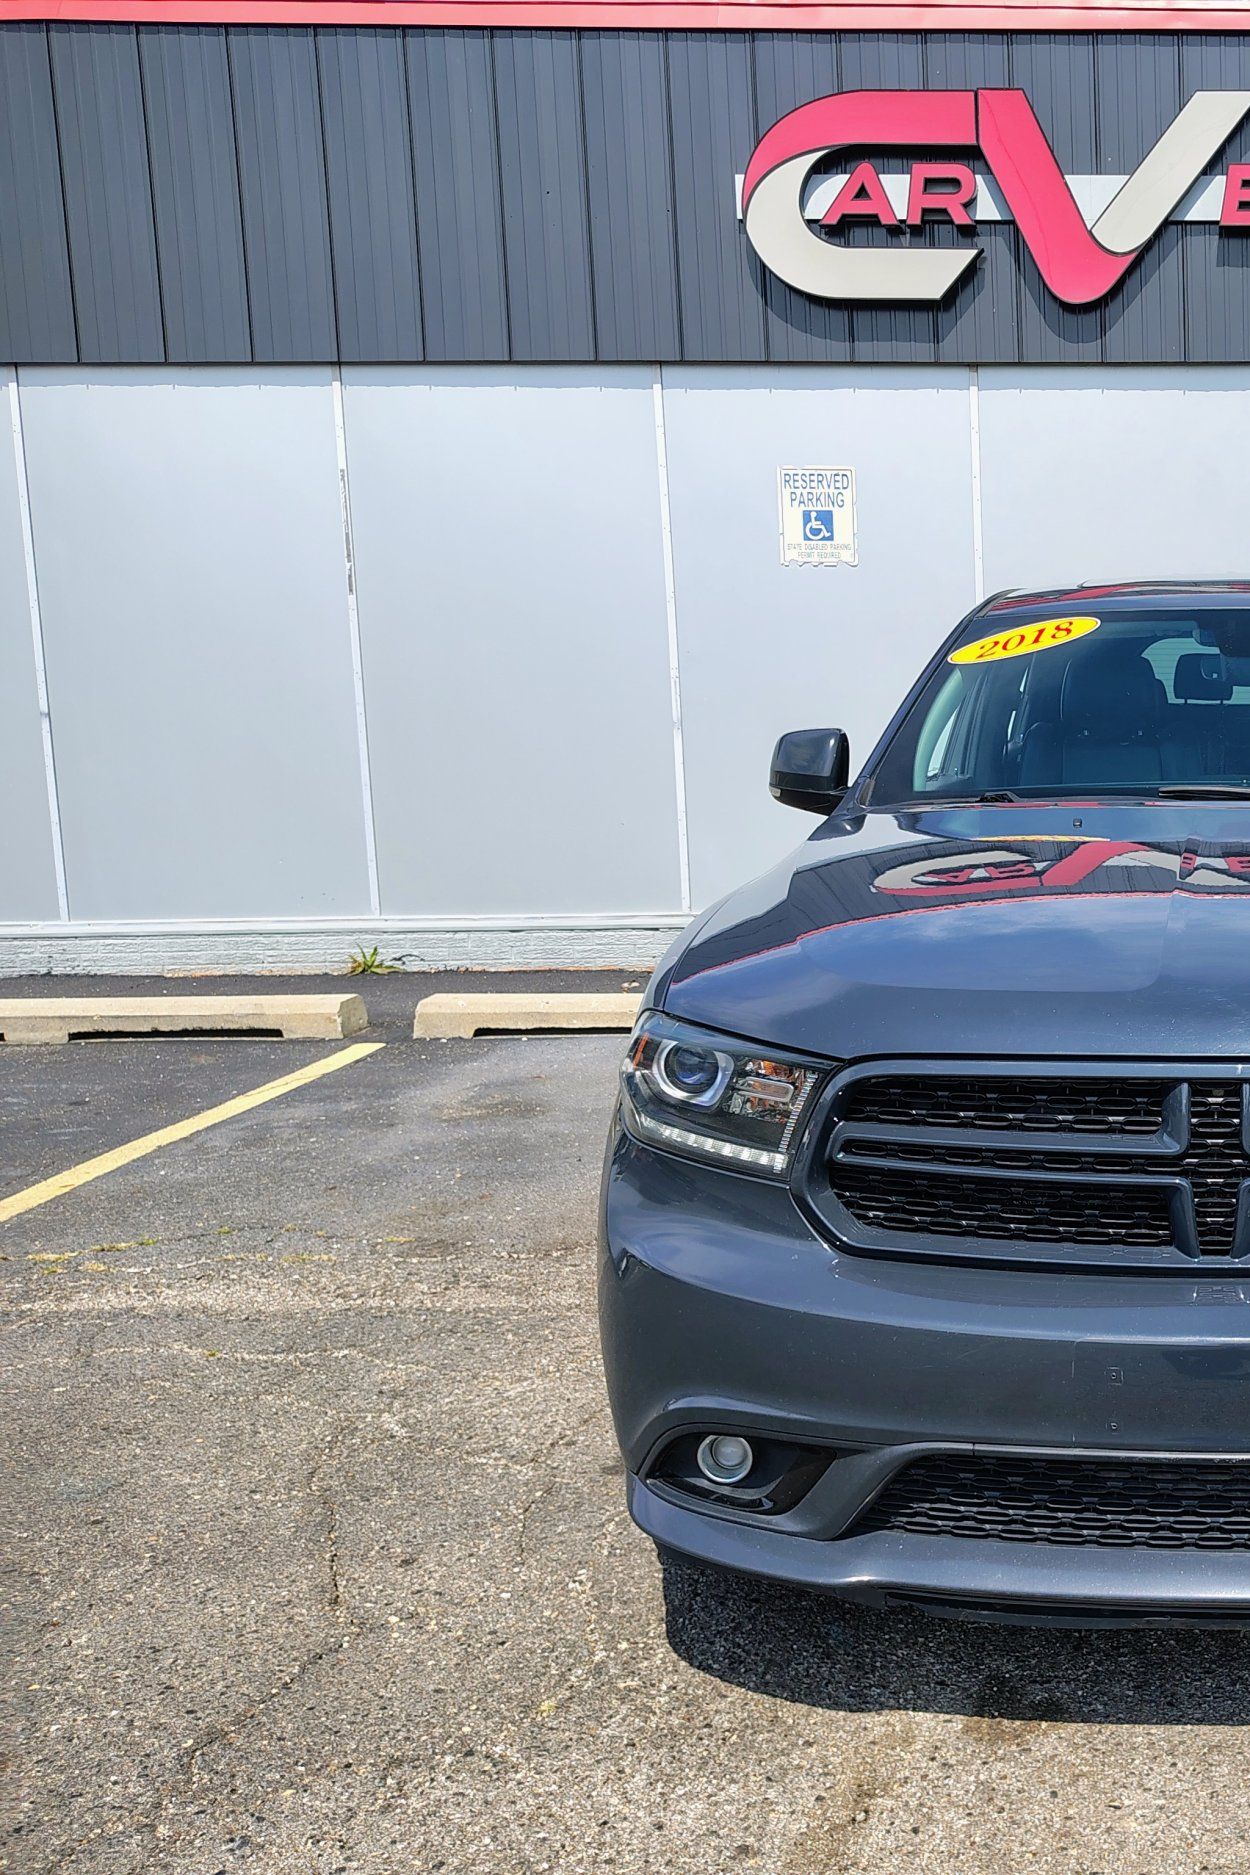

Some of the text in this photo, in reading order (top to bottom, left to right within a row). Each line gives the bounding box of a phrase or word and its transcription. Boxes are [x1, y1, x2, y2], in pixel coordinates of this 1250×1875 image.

[783, 473, 850, 490] RESERVED
[790, 492, 845, 508] PARKING
[976, 621, 1074, 660] 2018
